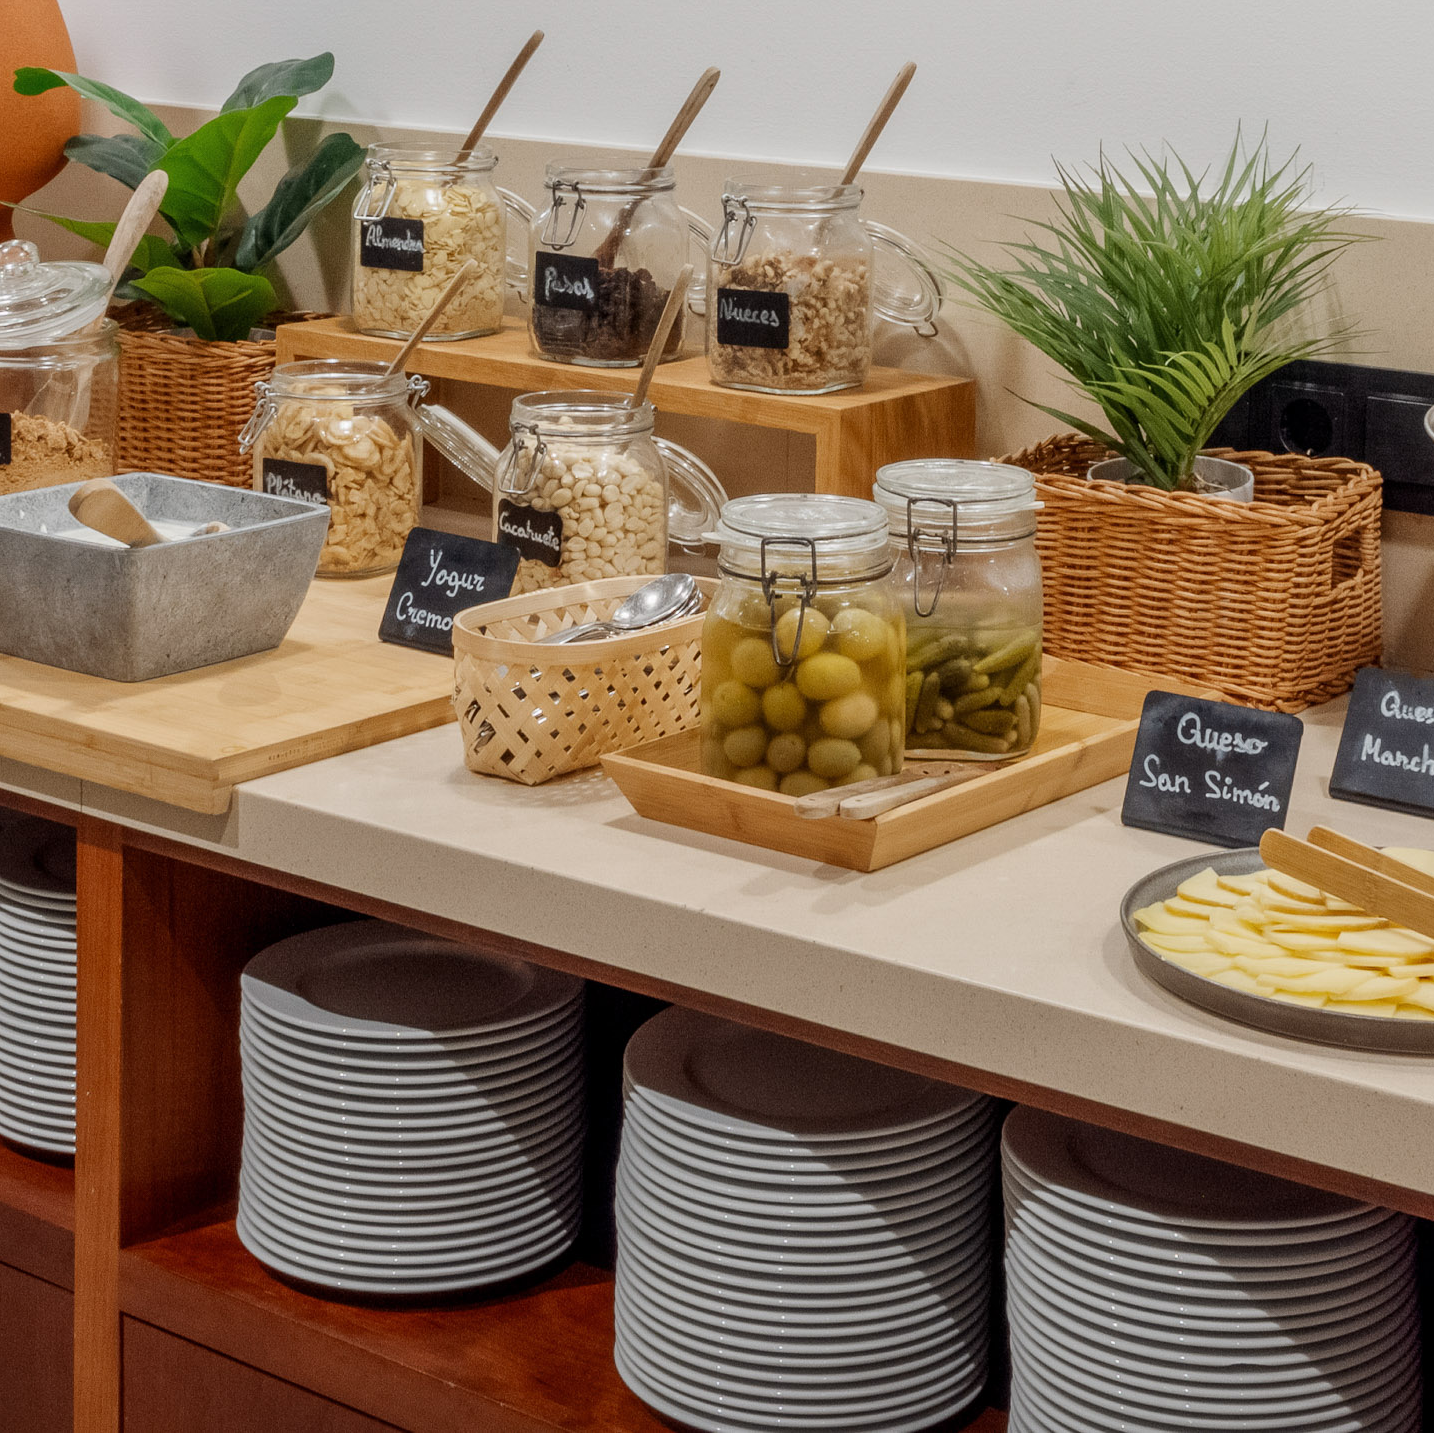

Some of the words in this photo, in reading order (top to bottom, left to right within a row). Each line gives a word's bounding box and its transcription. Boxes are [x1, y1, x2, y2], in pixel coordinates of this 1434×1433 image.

[420, 548, 486, 598] Yogur
[395, 591, 455, 631] Cremo
[1176, 711, 1269, 755] Queso
[1138, 753, 1192, 794] San
[1204, 769, 1281, 813] Simón
